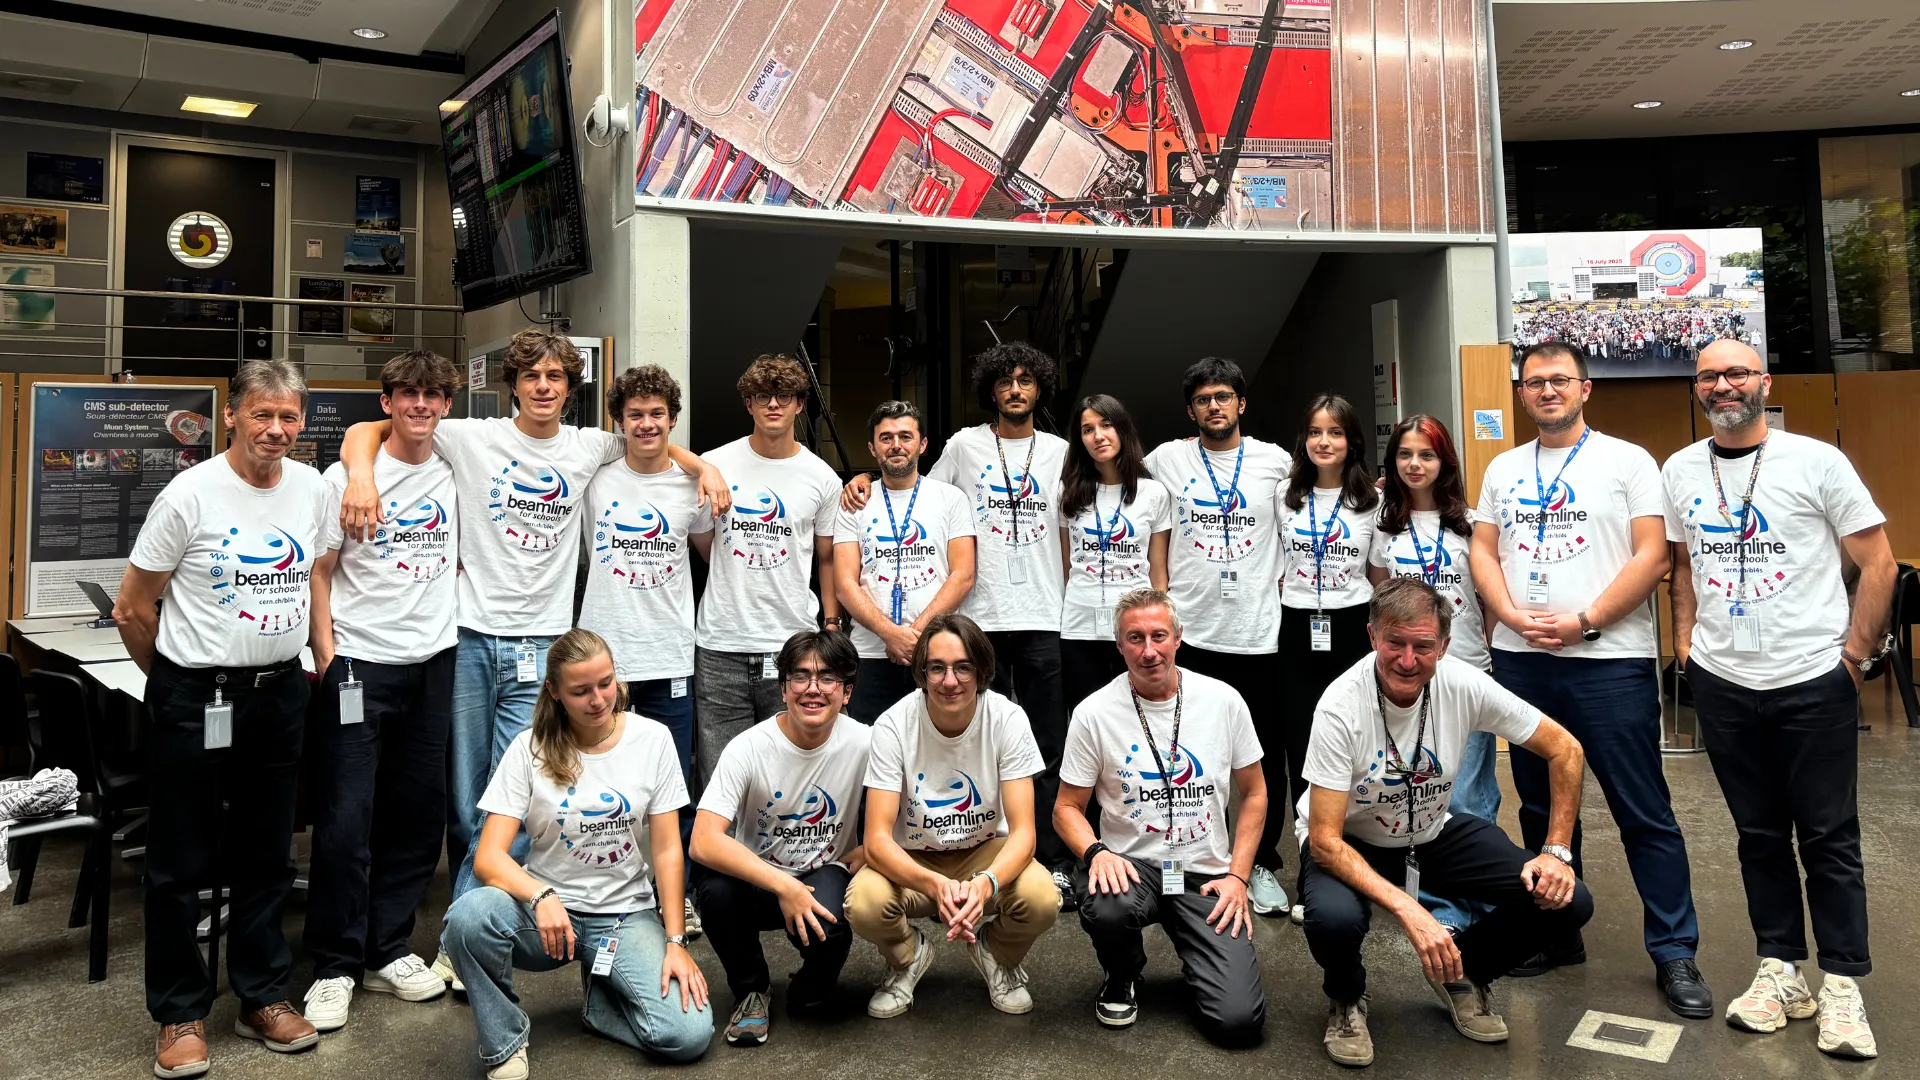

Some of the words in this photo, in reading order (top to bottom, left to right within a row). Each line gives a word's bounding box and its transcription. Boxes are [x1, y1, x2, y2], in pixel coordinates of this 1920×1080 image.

[954, 56, 996, 89] MB/+2/3/9
[747, 58, 777, 102] MB/+2/x/09
[83, 401, 106, 411] CMS
[108, 402, 170, 411] sub-detector
[316, 405, 337, 414] Data
[85, 412, 146, 420] Sous-détecteur
[507, 494, 573, 516] beamline
[519, 510, 531, 518] for
[533, 512, 562, 522] schools
[1515, 507, 1588, 524] beamline
[731, 517, 792, 536] beamline
[393, 528, 449, 543] beamlin
[743, 530, 754, 538] for
[755, 533, 780, 541] schools
[421, 541, 446, 549] school
[611, 534, 677, 552] beamline
[623, 549, 636, 557] for
[637, 550, 665, 559] schools
[875, 543, 936, 559] beamline
[1718, 555, 1731, 563] for
[234, 567, 310, 587] beamline
[252, 586, 267, 595] for
[269, 585, 301, 594] schools
[258, 597, 296, 605] cern.ch/bl4s
[1139, 782, 1215, 802] beamline
[1155, 800, 1169, 809] for
[1171, 799, 1204, 808] schools
[923, 809, 996, 829] beamline
[604, 827, 630, 837] schools
[773, 821, 844, 839] beamline
[936, 827, 950, 836] for
[951, 825, 983, 834] schools
[799, 835, 831, 845] schools
